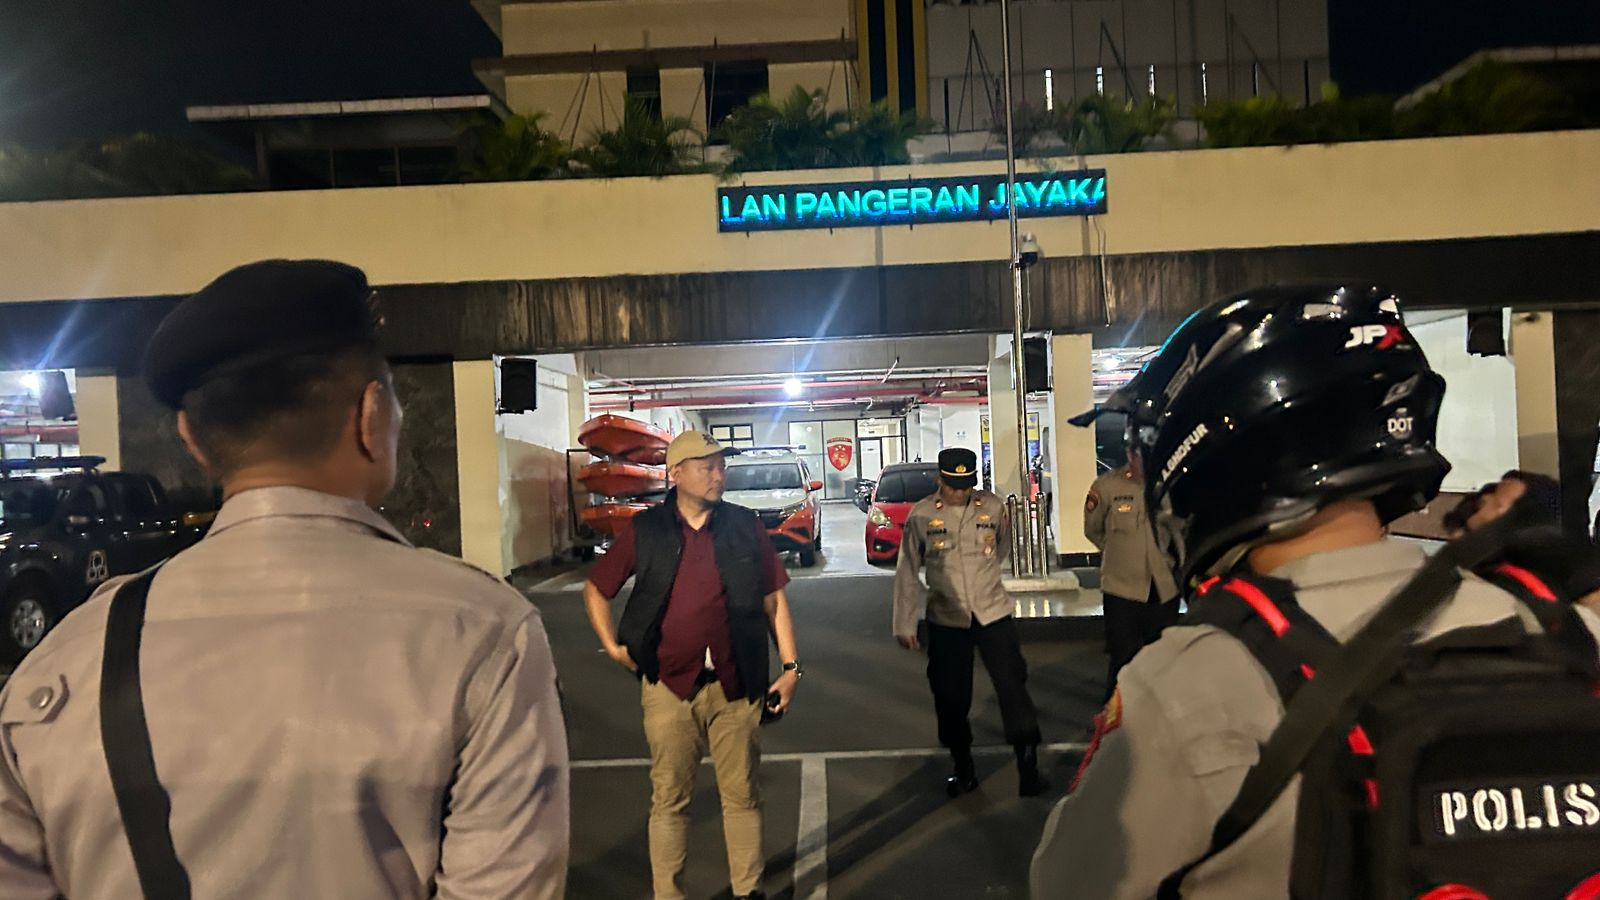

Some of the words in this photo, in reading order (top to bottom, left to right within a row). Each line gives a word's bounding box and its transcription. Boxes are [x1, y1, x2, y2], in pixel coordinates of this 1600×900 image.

[795, 184, 980, 219] PANGERAN
[1344, 323, 1405, 351] JPX
[1387, 416, 1414, 433] DOT
[1441, 783, 1600, 835] POLIS
